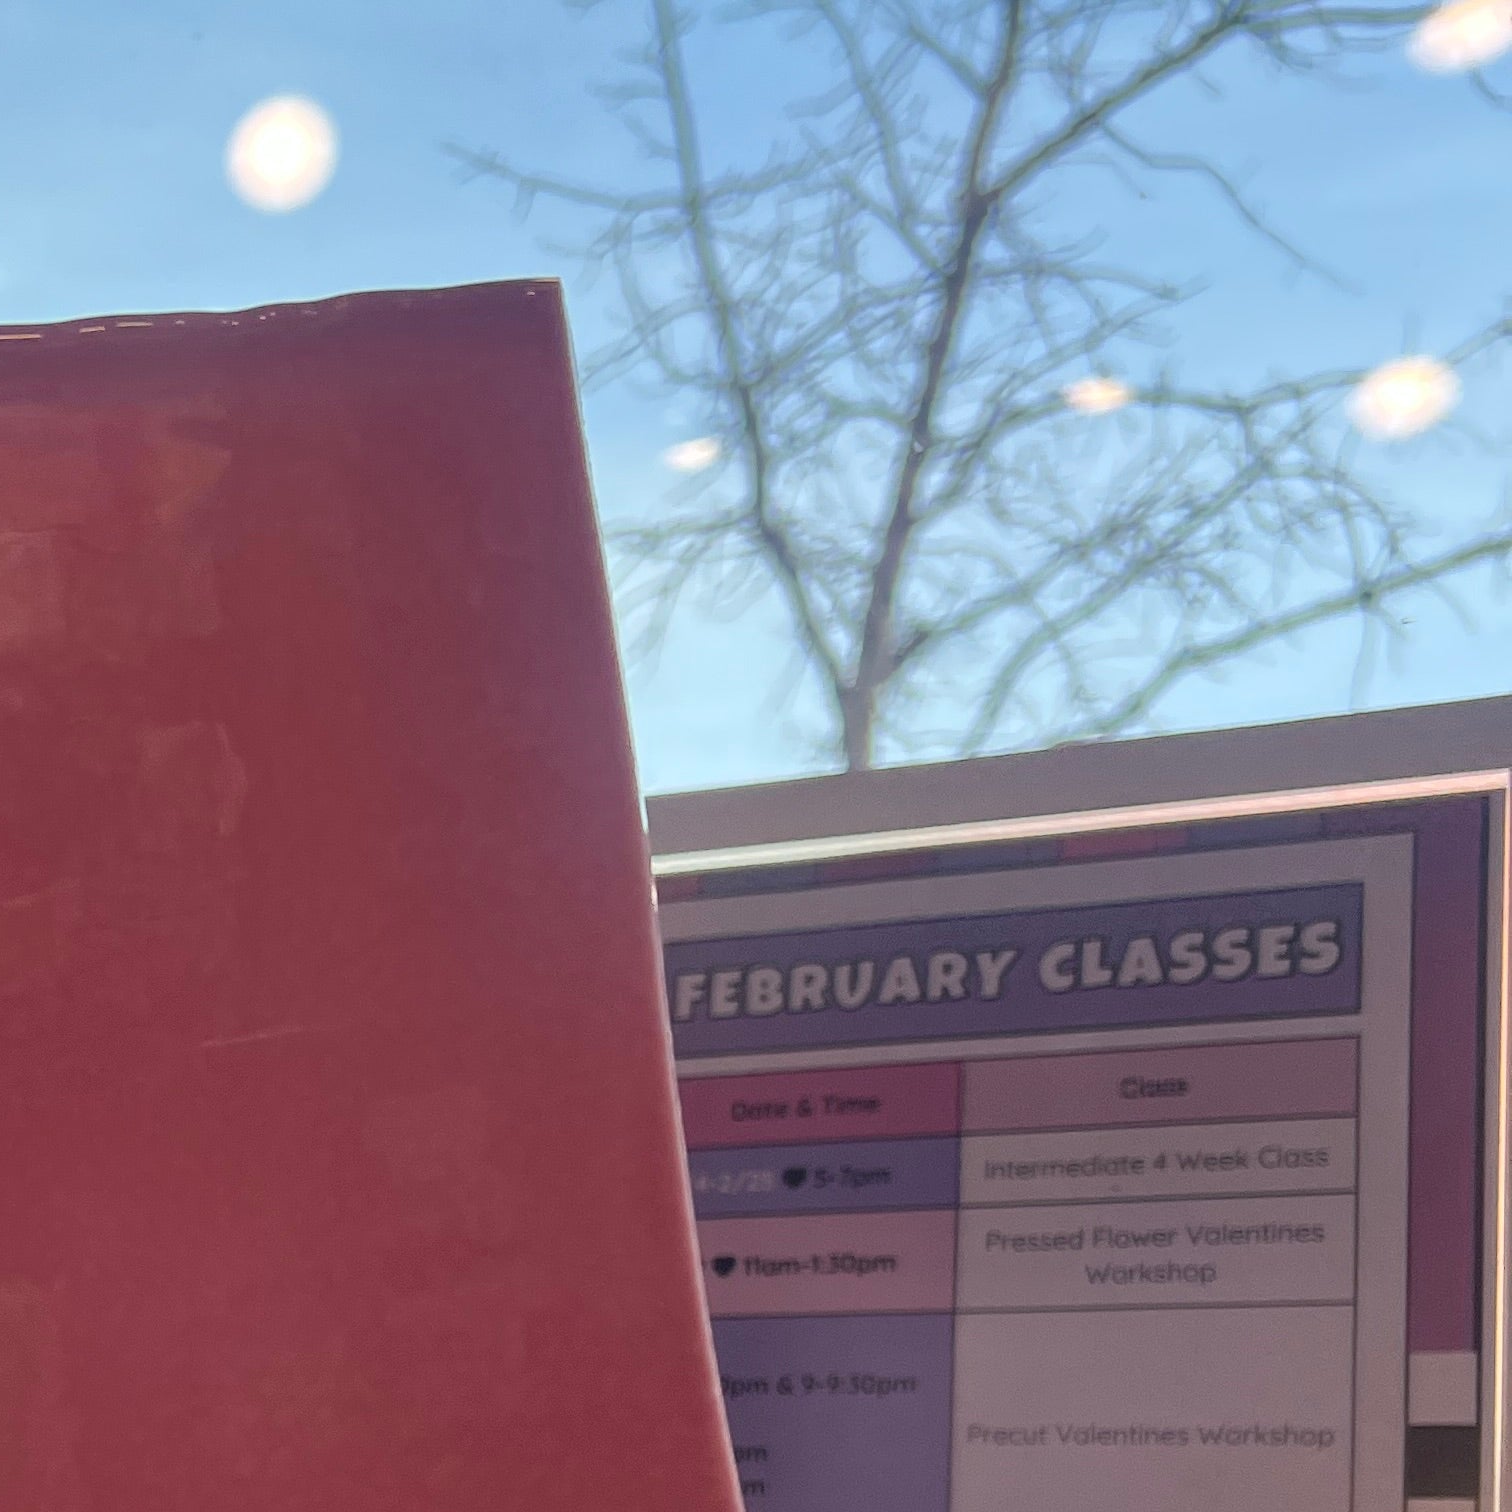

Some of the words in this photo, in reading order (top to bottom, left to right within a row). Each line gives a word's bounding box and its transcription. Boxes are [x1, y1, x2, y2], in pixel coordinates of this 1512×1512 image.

[672, 947, 1018, 1022] FEBRUARY
[1038, 920, 1341, 993] CLASSES
[731, 1101, 788, 1122] Date
[797, 1098, 813, 1119] &
[824, 1095, 882, 1115] Time
[985, 1155, 1145, 1180] Intermediate
[1153, 1151, 1167, 1171] 4
[1177, 1149, 1249, 1172] Week
[1257, 1145, 1330, 1169] Class
[985, 1227, 1085, 1252] Pressed
[1092, 1224, 1176, 1249] Flower
[1187, 1221, 1325, 1246] Valentines
[1086, 1262, 1218, 1287] Workshop
[966, 1423, 1047, 1446] Precut
[1055, 1423, 1189, 1447] Valentines
[1199, 1424, 1336, 1450] Workshop
